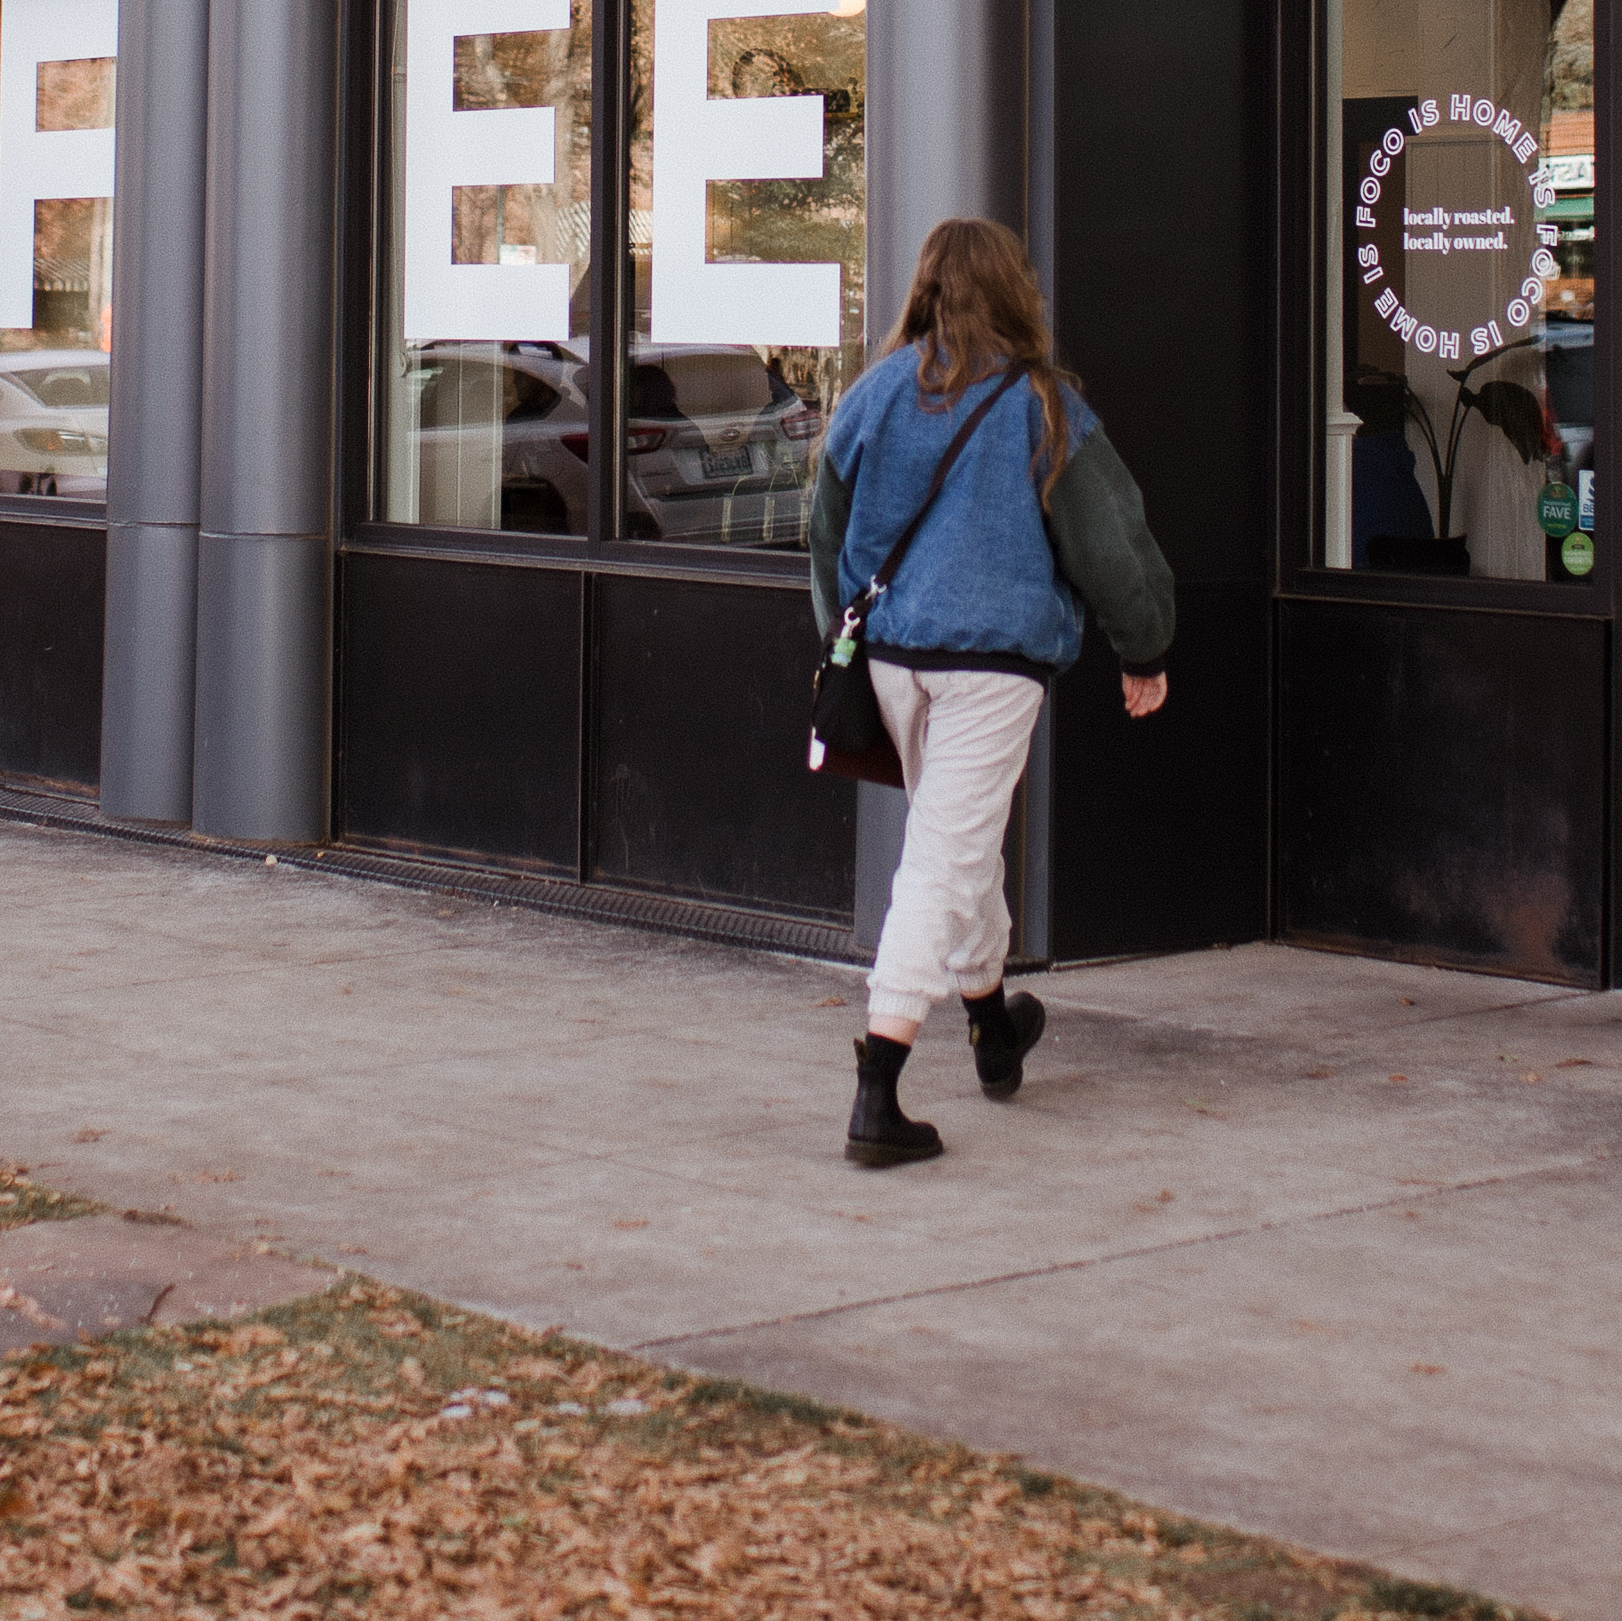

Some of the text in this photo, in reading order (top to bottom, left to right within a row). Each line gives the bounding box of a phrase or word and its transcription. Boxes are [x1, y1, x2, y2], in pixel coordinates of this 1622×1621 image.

[1407, 99, 1440, 134] IS
[1450, 94, 1538, 165] HOME
[1356, 127, 1404, 228] FOCO
[1403, 206, 1515, 229] locally roasted.
[1403, 231, 1508, 255] locally owned.
[1358, 243, 1384, 285] IS
[1507, 224, 1559, 327] FOCO
[1374, 287, 1460, 360] HOME
[1470, 320, 1504, 355] IS
[1543, 505, 1572, 520] FAVE
